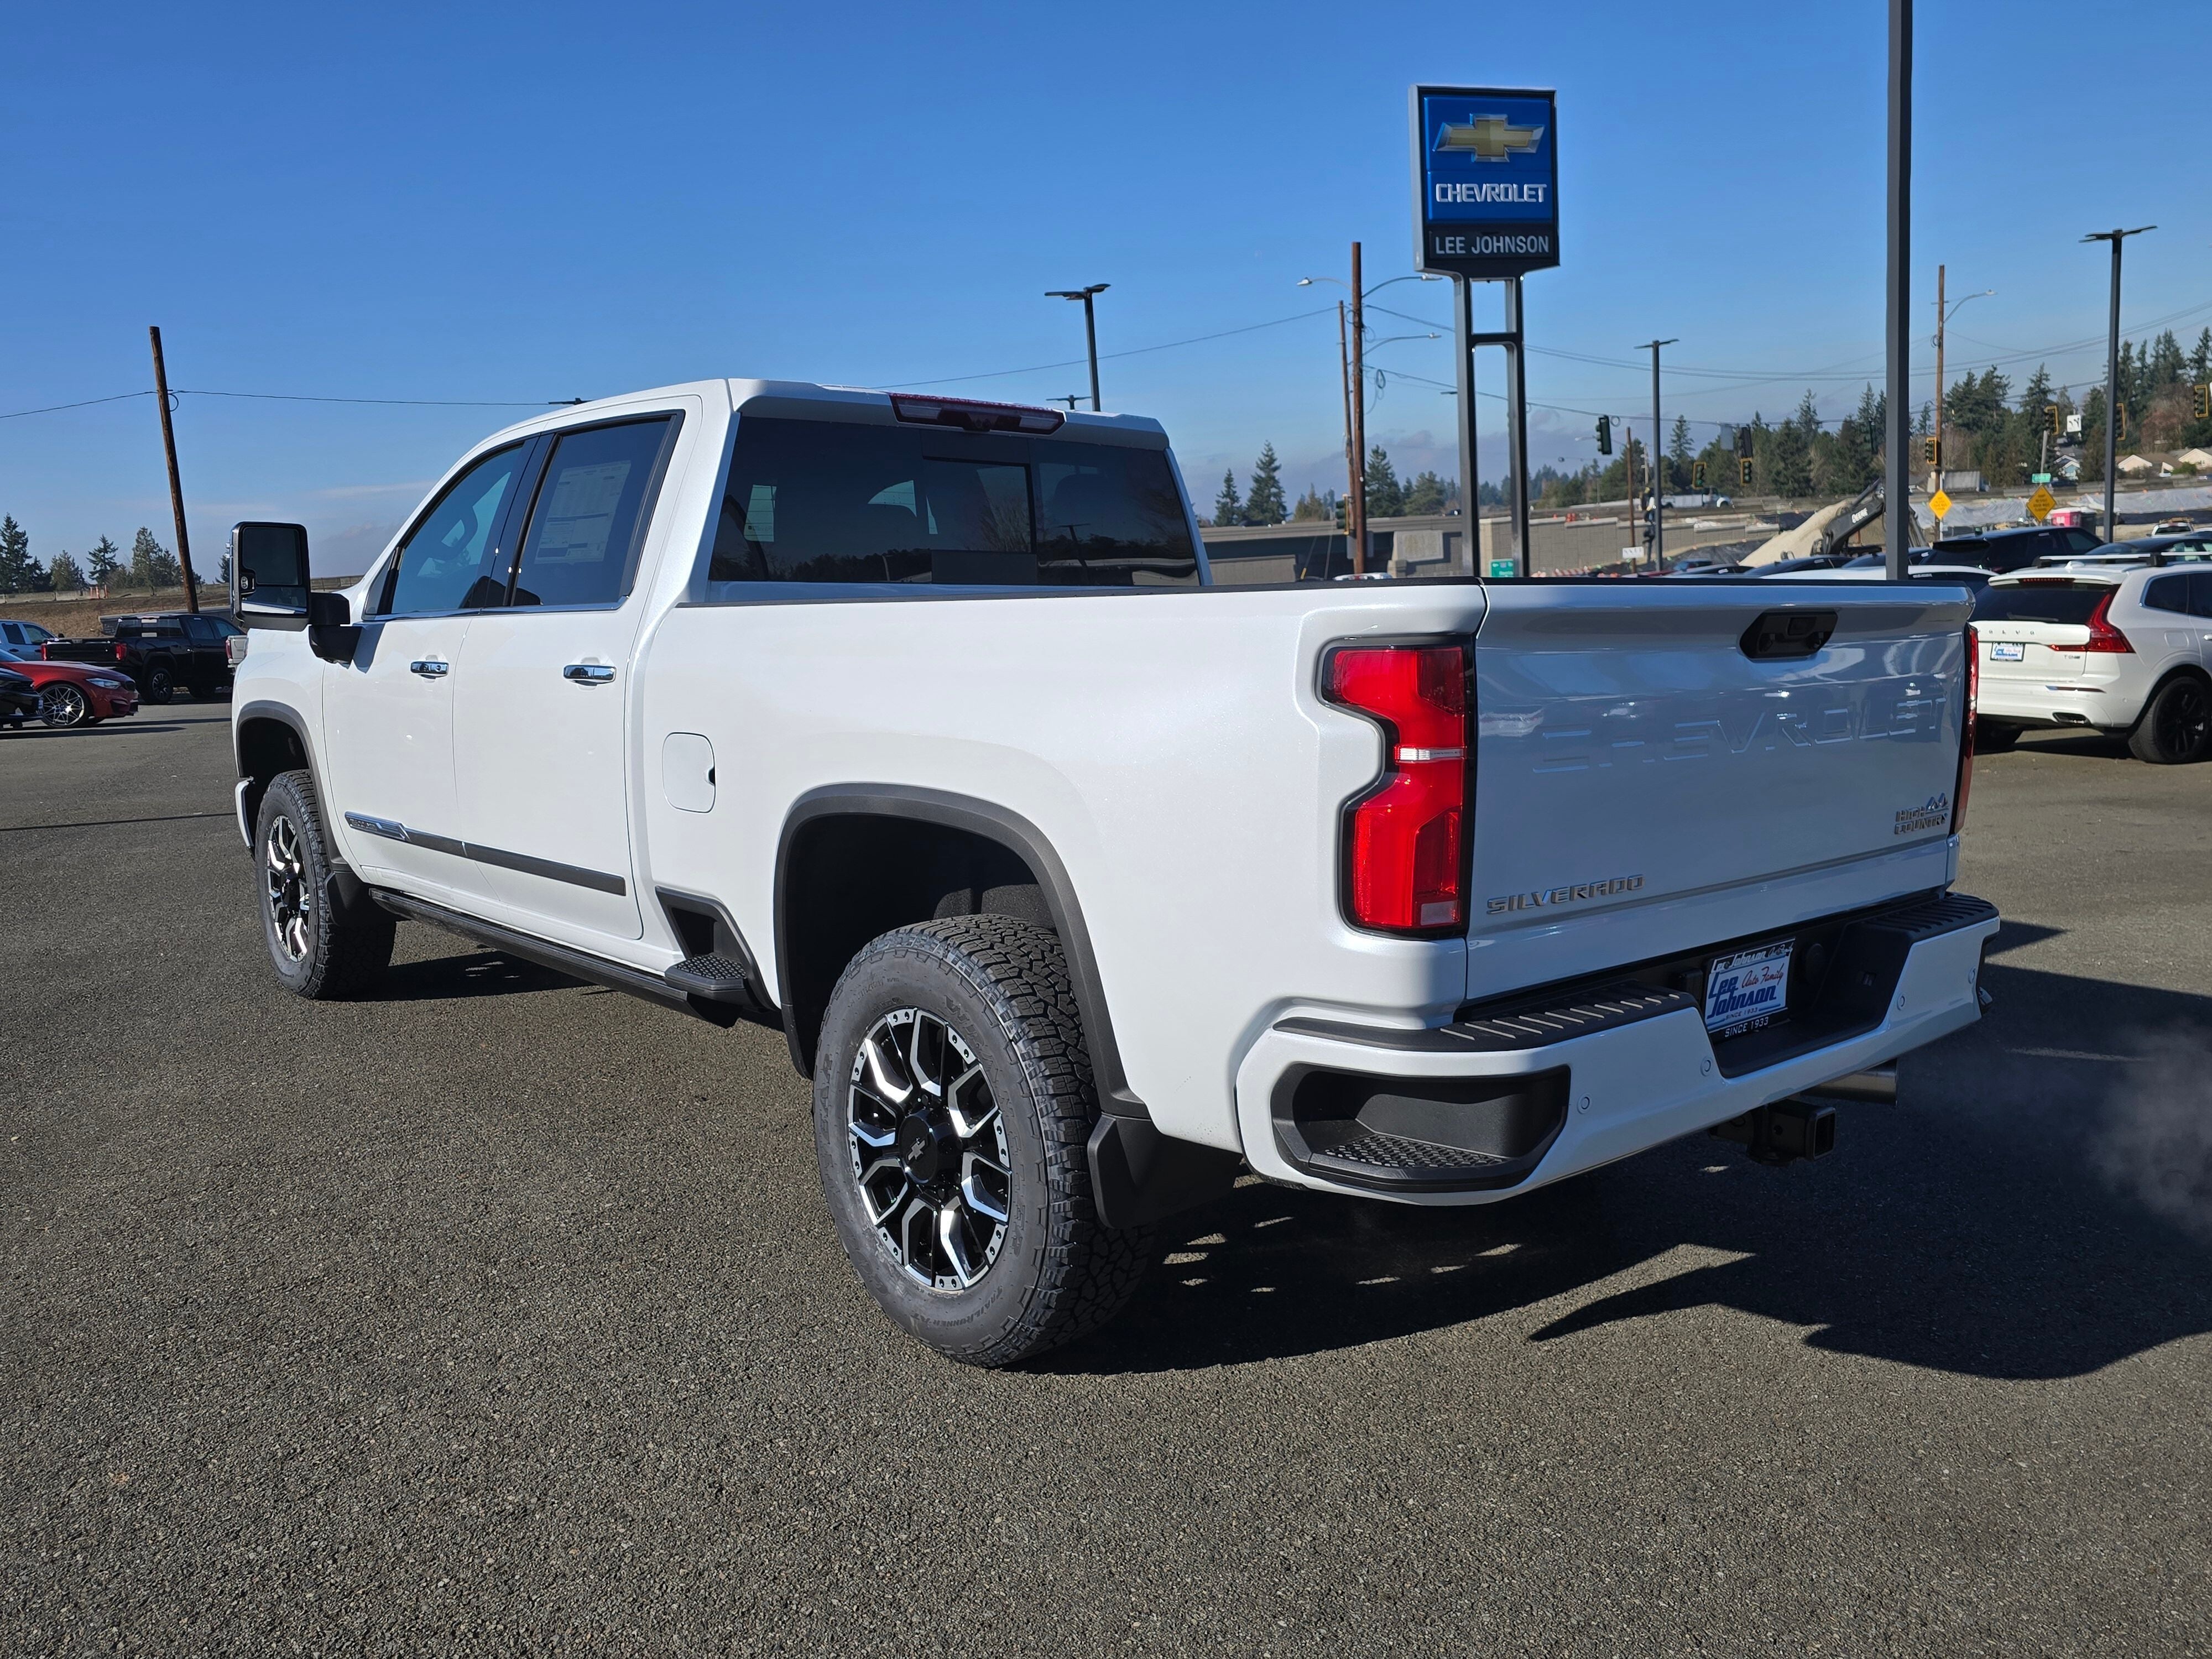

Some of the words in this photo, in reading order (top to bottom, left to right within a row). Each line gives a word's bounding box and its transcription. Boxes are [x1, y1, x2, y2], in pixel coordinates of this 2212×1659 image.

[1436, 183, 1547, 203] CHEVROLET
[1435, 237, 1466, 254] LEE
[1471, 235, 1550, 254] JOHNSON
[1486, 873, 1646, 915] SILVERADO
[1708, 972, 1739, 1000] Lee
[1741, 970, 1759, 989] Auto
[1760, 963, 1785, 986] Family
[1707, 985, 1777, 1020] Johnson
[1725, 1011, 1741, 1021] SINCE
[1744, 1007, 1759, 1015] 1933
[1724, 1022, 1748, 1037] SINCE
[1751, 1016, 1770, 1030] 1933
